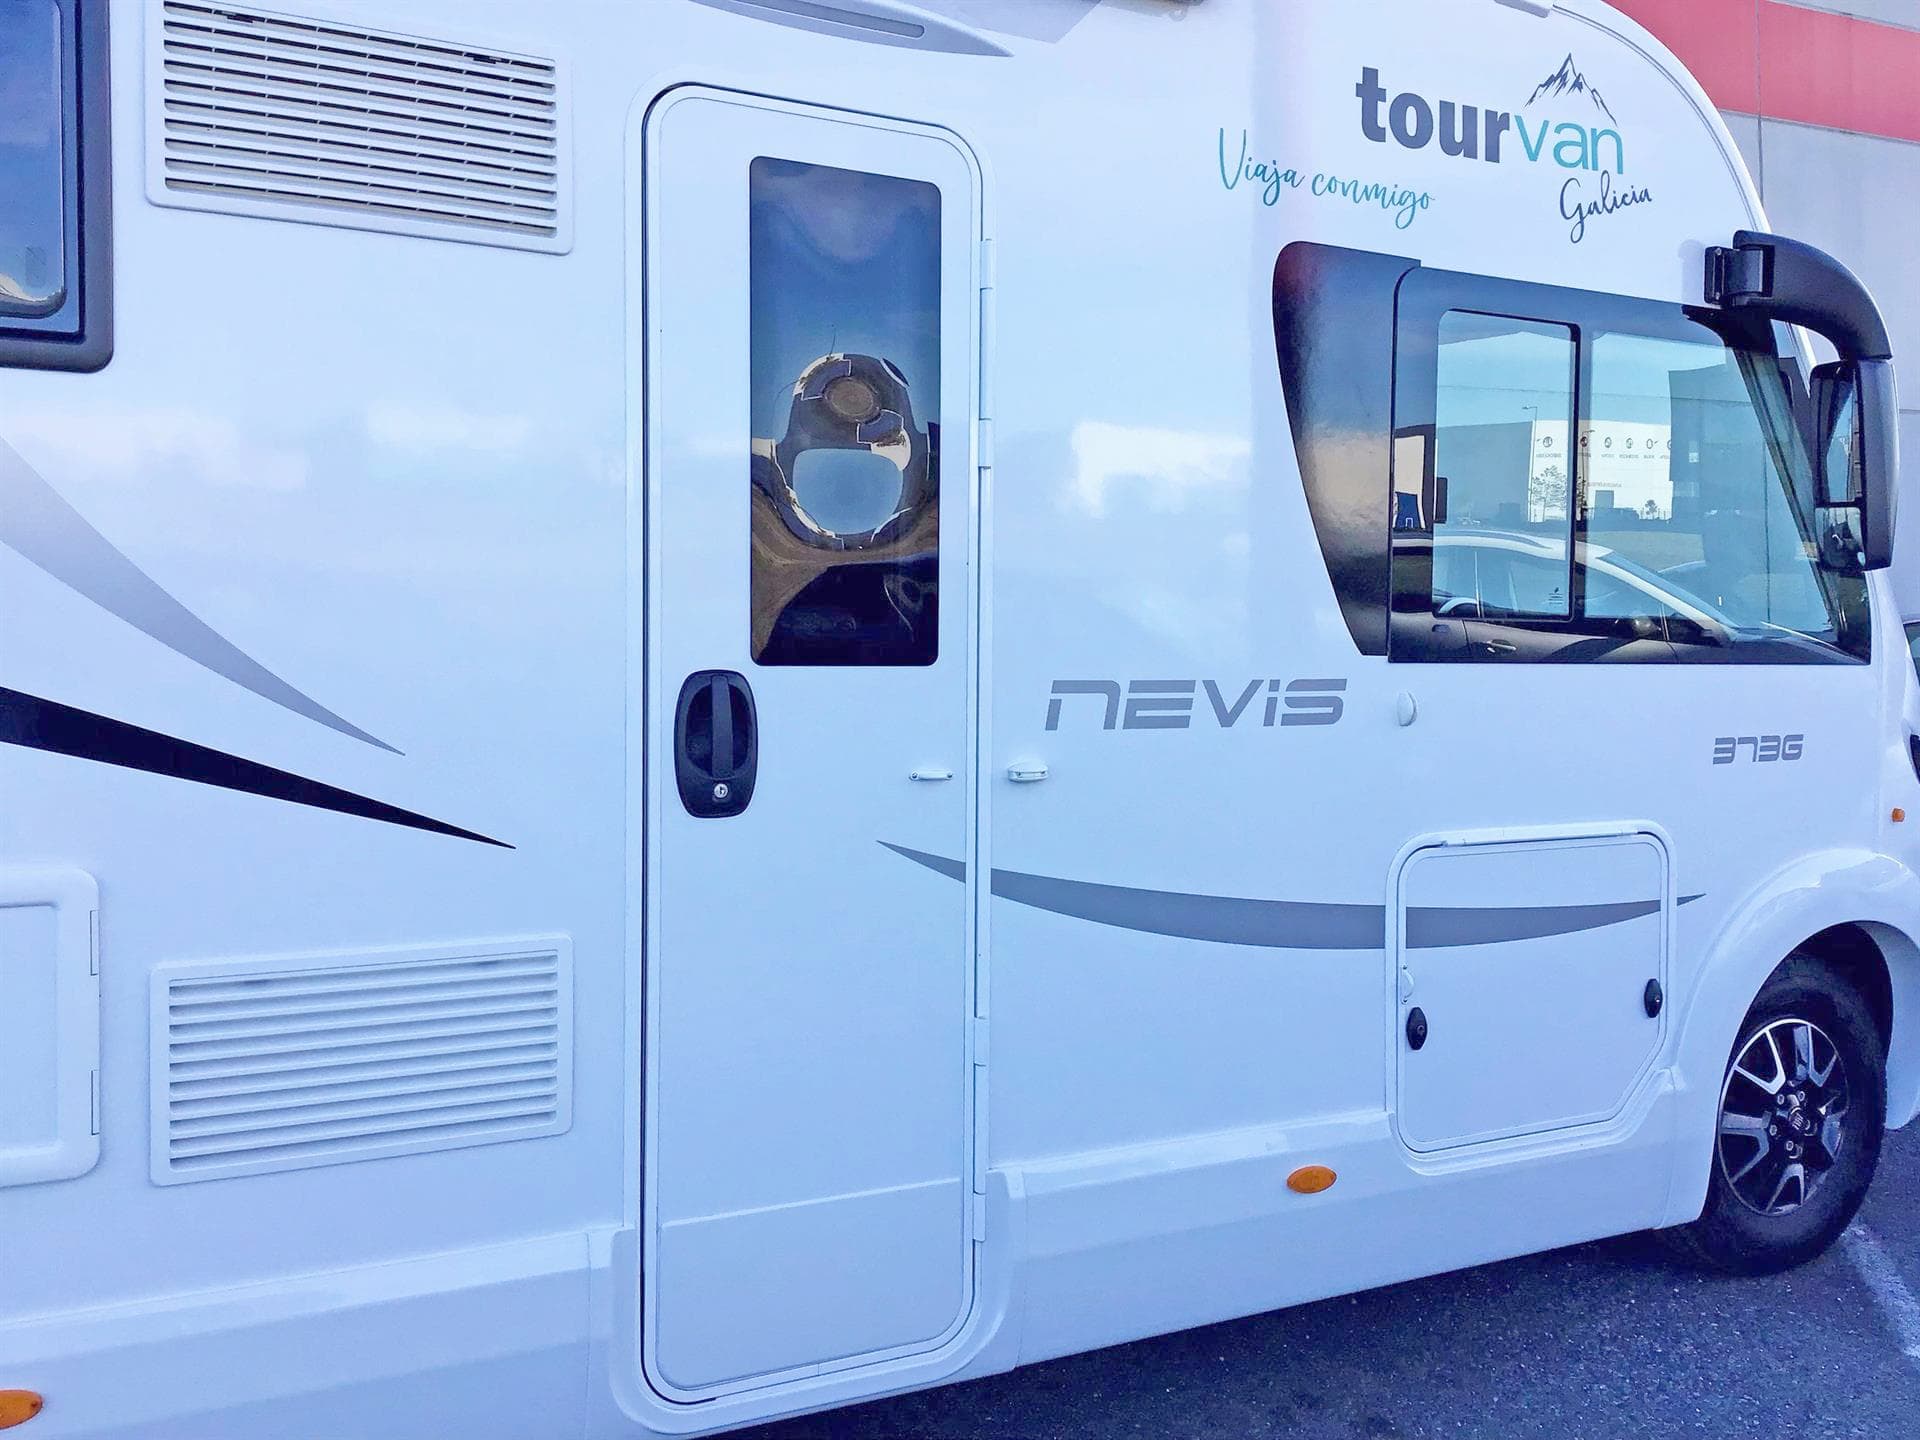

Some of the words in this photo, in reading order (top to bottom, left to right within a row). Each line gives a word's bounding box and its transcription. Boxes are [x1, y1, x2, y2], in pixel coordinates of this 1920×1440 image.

[1219, 127, 1304, 207] Viaja
[1311, 172, 1435, 230] conmigo
[1559, 170, 1653, 243] Galicia
[1712, 733, 1805, 765] 373G
